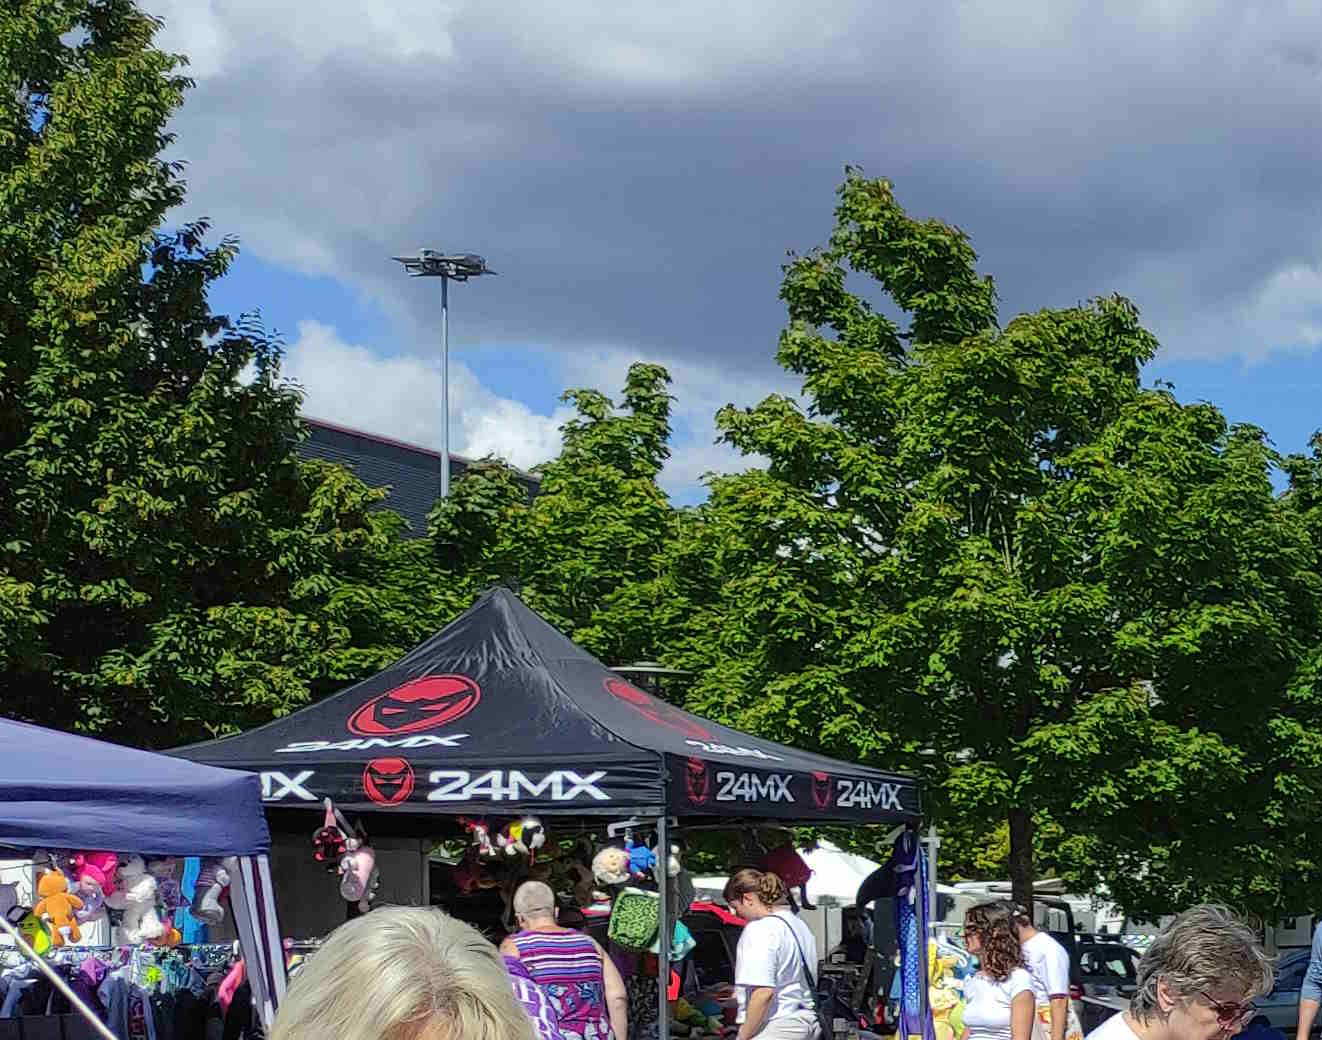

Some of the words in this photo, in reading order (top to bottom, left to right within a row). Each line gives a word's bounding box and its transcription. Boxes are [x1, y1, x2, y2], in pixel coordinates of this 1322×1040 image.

[427, 771, 612, 800] 24MX
[715, 771, 795, 802] 24MX
[836, 780, 904, 810] 24MX
